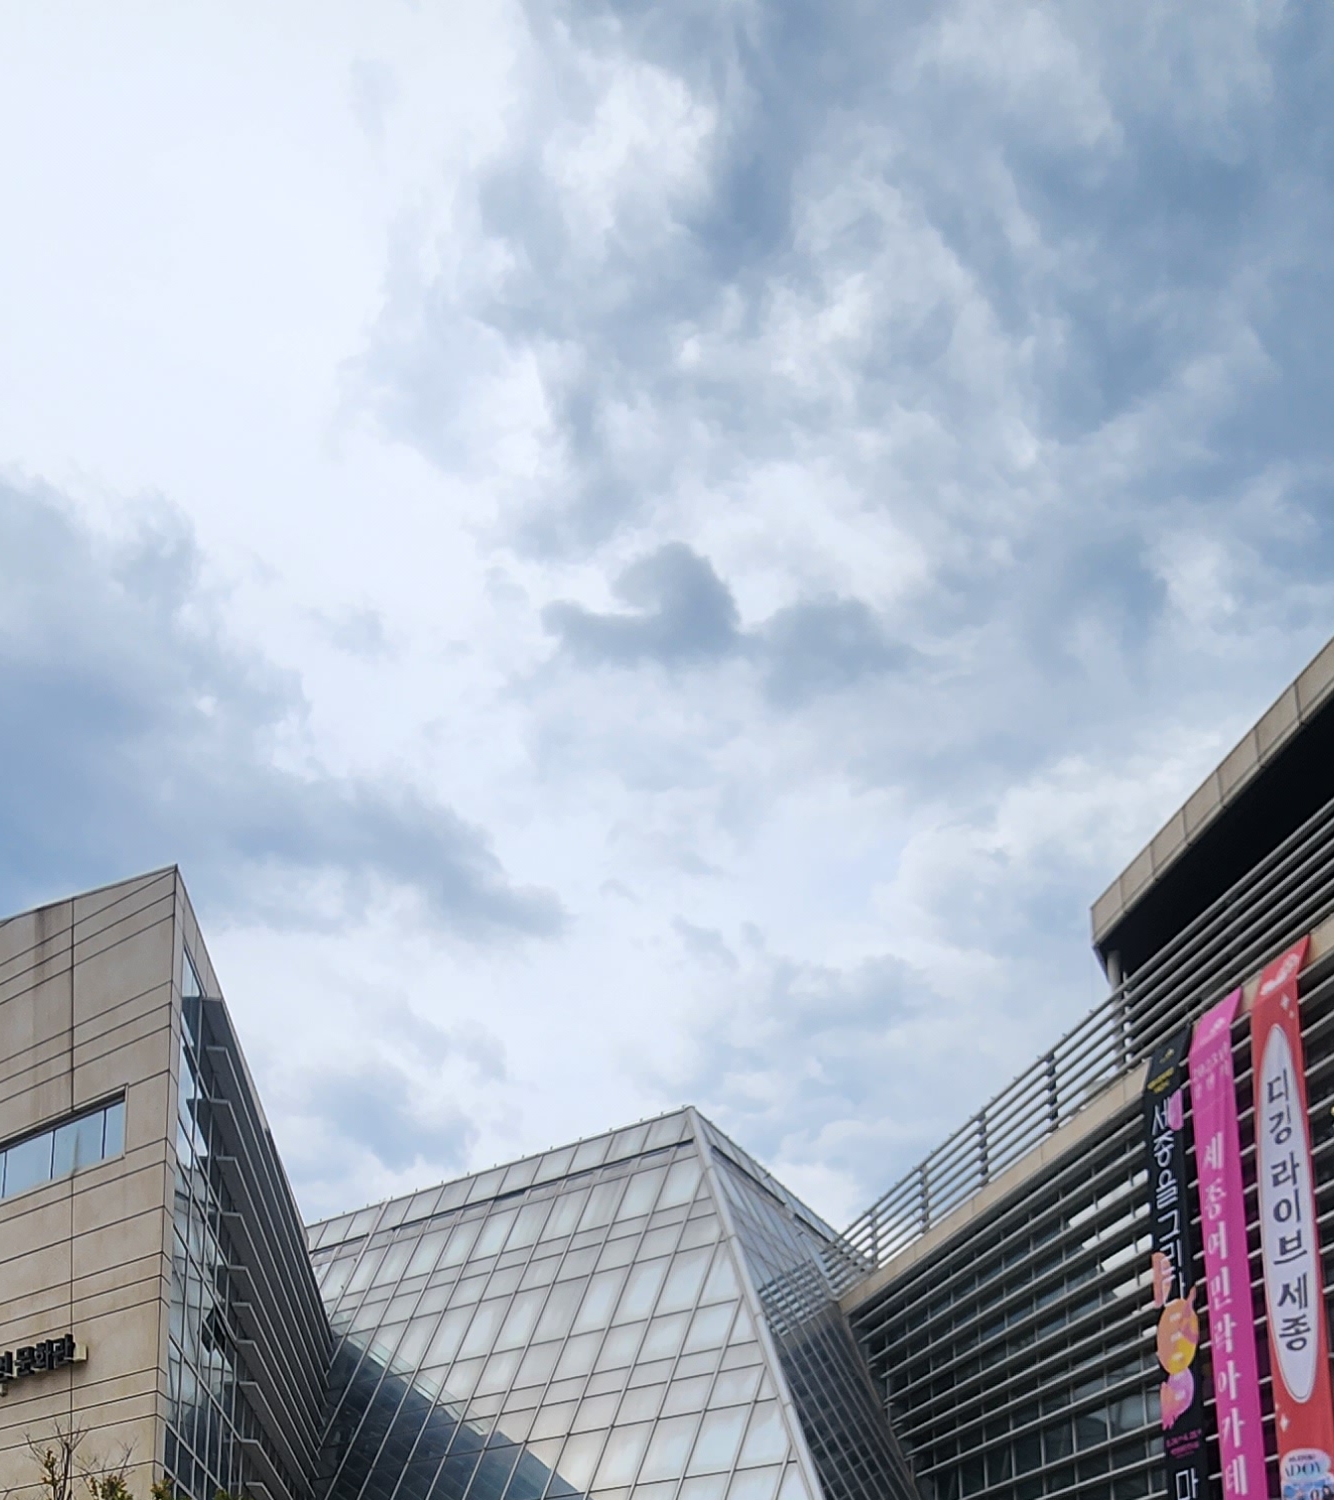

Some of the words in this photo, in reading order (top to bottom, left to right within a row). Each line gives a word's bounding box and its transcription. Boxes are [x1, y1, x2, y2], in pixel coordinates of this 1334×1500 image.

[1267, 1068, 1292, 1145] 디깅
[1270, 1150, 1308, 1266] 라이브
[1276, 1271, 1312, 1352] 세종
